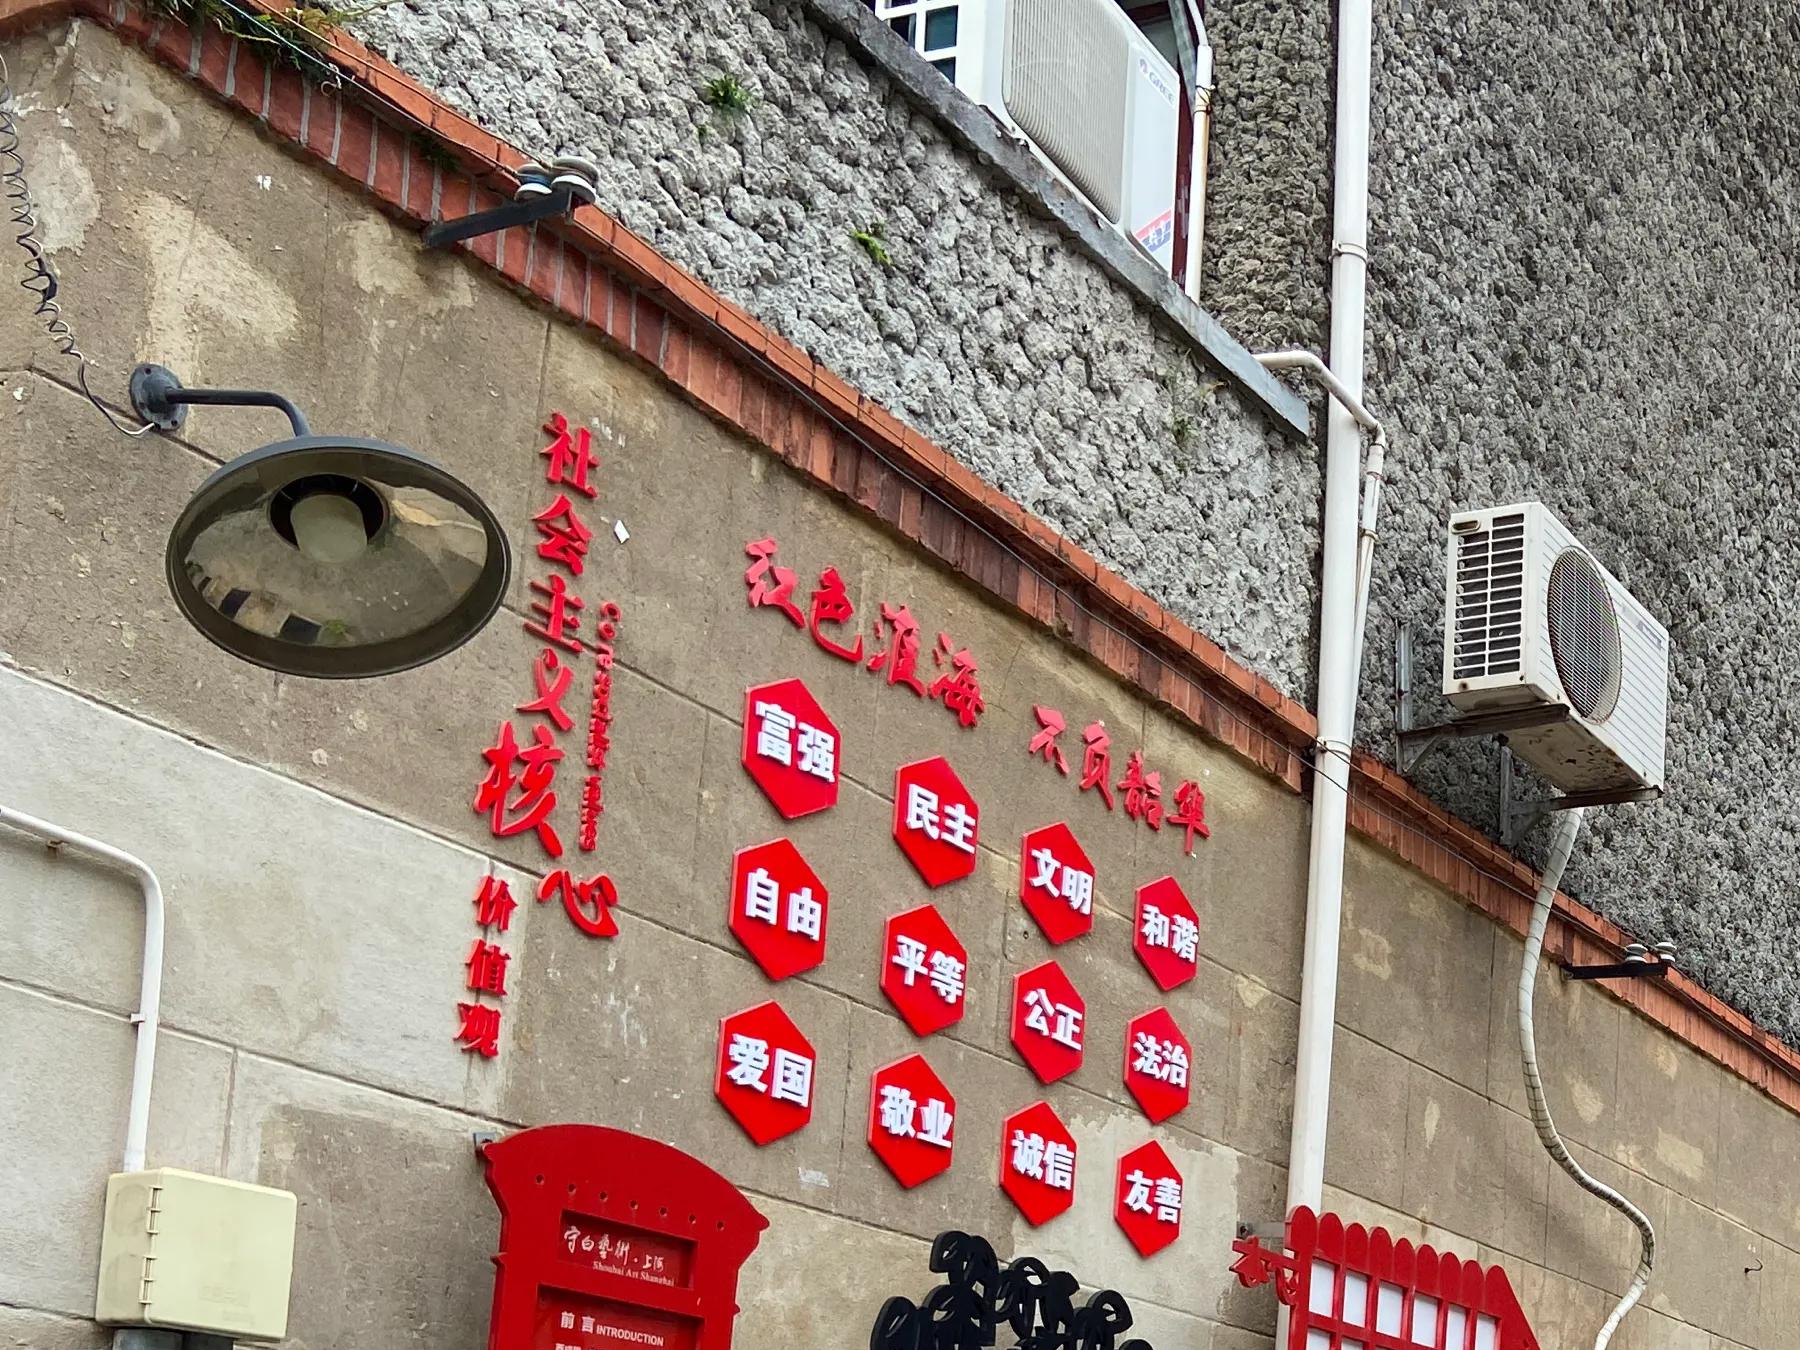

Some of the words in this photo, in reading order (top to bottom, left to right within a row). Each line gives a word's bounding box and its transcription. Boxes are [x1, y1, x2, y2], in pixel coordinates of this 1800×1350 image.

[596, 602, 621, 669] core
[744, 536, 985, 728] 红色淮海
[755, 700, 836, 783] 富强
[905, 783, 976, 854] 民主
[743, 868, 823, 942] 自由
[1030, 847, 1095, 917] 文明
[1142, 902, 1199, 965] 和谐
[892, 934, 967, 1005] 平等
[1023, 987, 1084, 1052] 公正
[727, 1032, 813, 1108] 爱国
[1132, 1031, 1190, 1089] 法治
[879, 1084, 953, 1150] 敬业
[1011, 1128, 1077, 1192] 诚信
[1124, 1168, 1183, 1225] 友善
[626, 1268, 640, 1279] Art
[640, 1270, 675, 1287] Shanghai
[560, 1311, 594, 1334] 前言
[596, 1325, 664, 1347] INTRODUCTION
